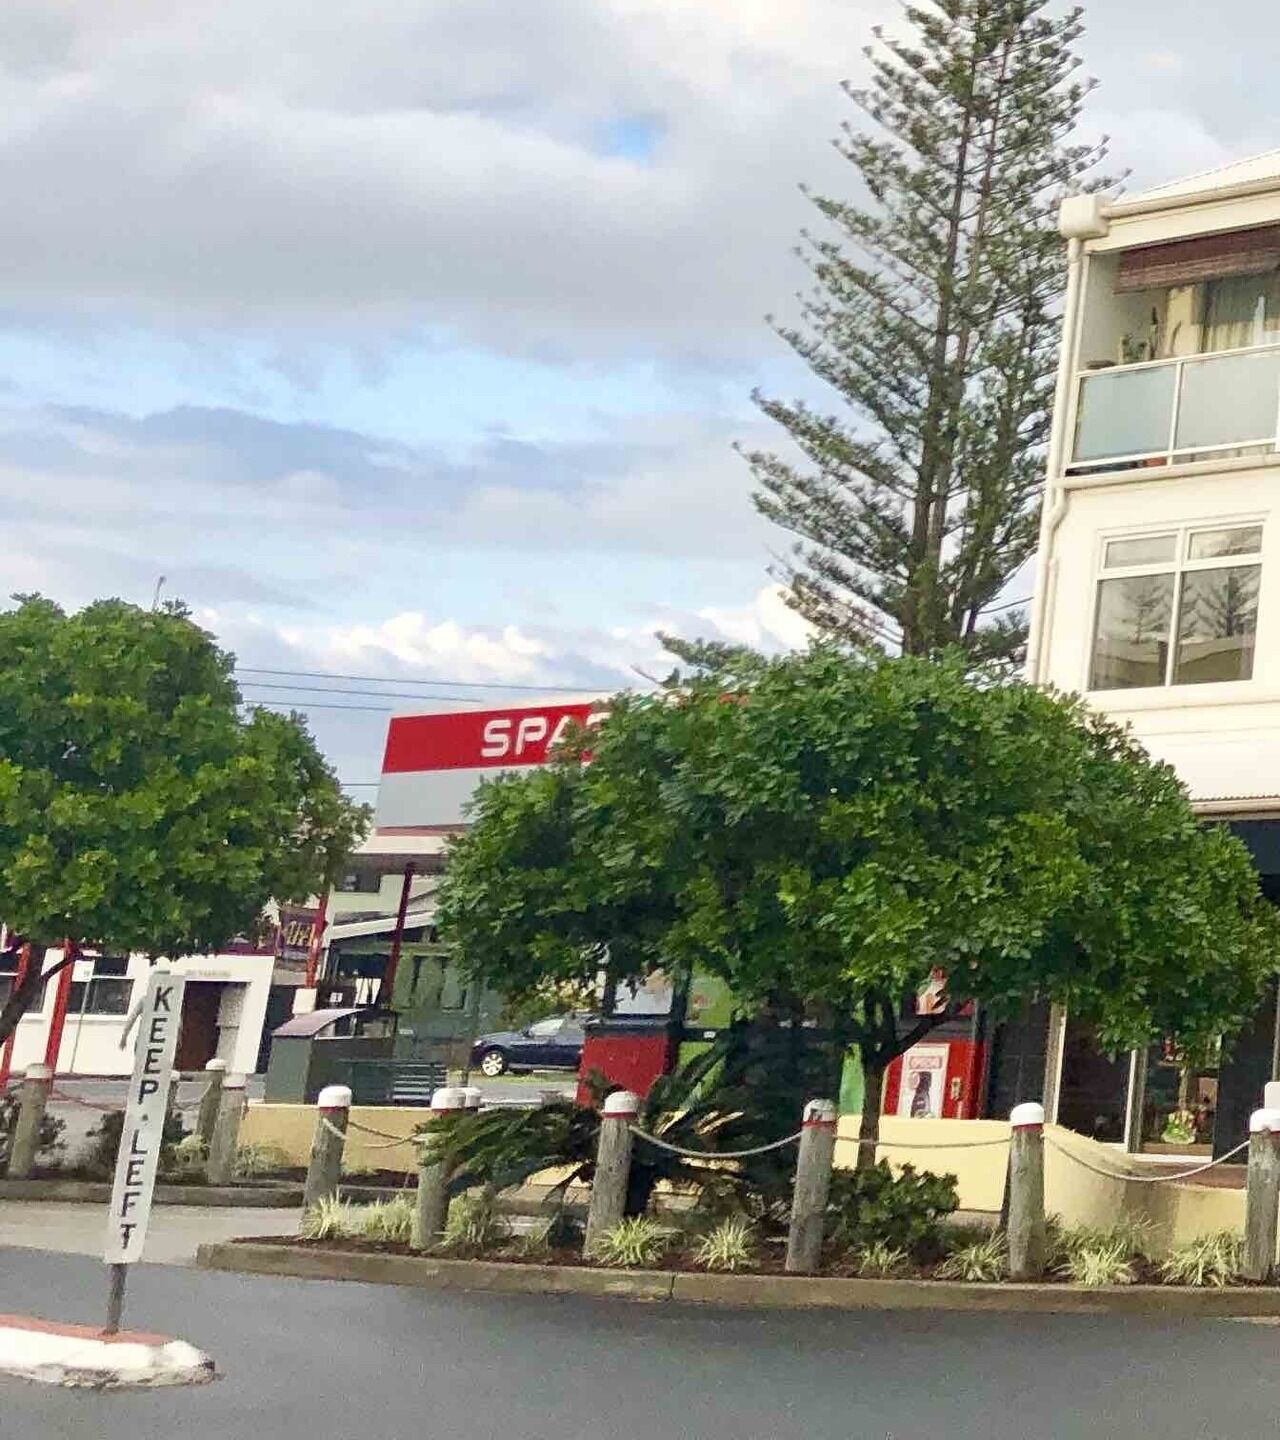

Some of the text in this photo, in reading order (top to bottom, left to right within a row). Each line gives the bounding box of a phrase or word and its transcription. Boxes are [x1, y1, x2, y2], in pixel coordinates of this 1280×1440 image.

[481, 712, 611, 762] SPA
[120, 986, 174, 1250] KEEP LEFT
